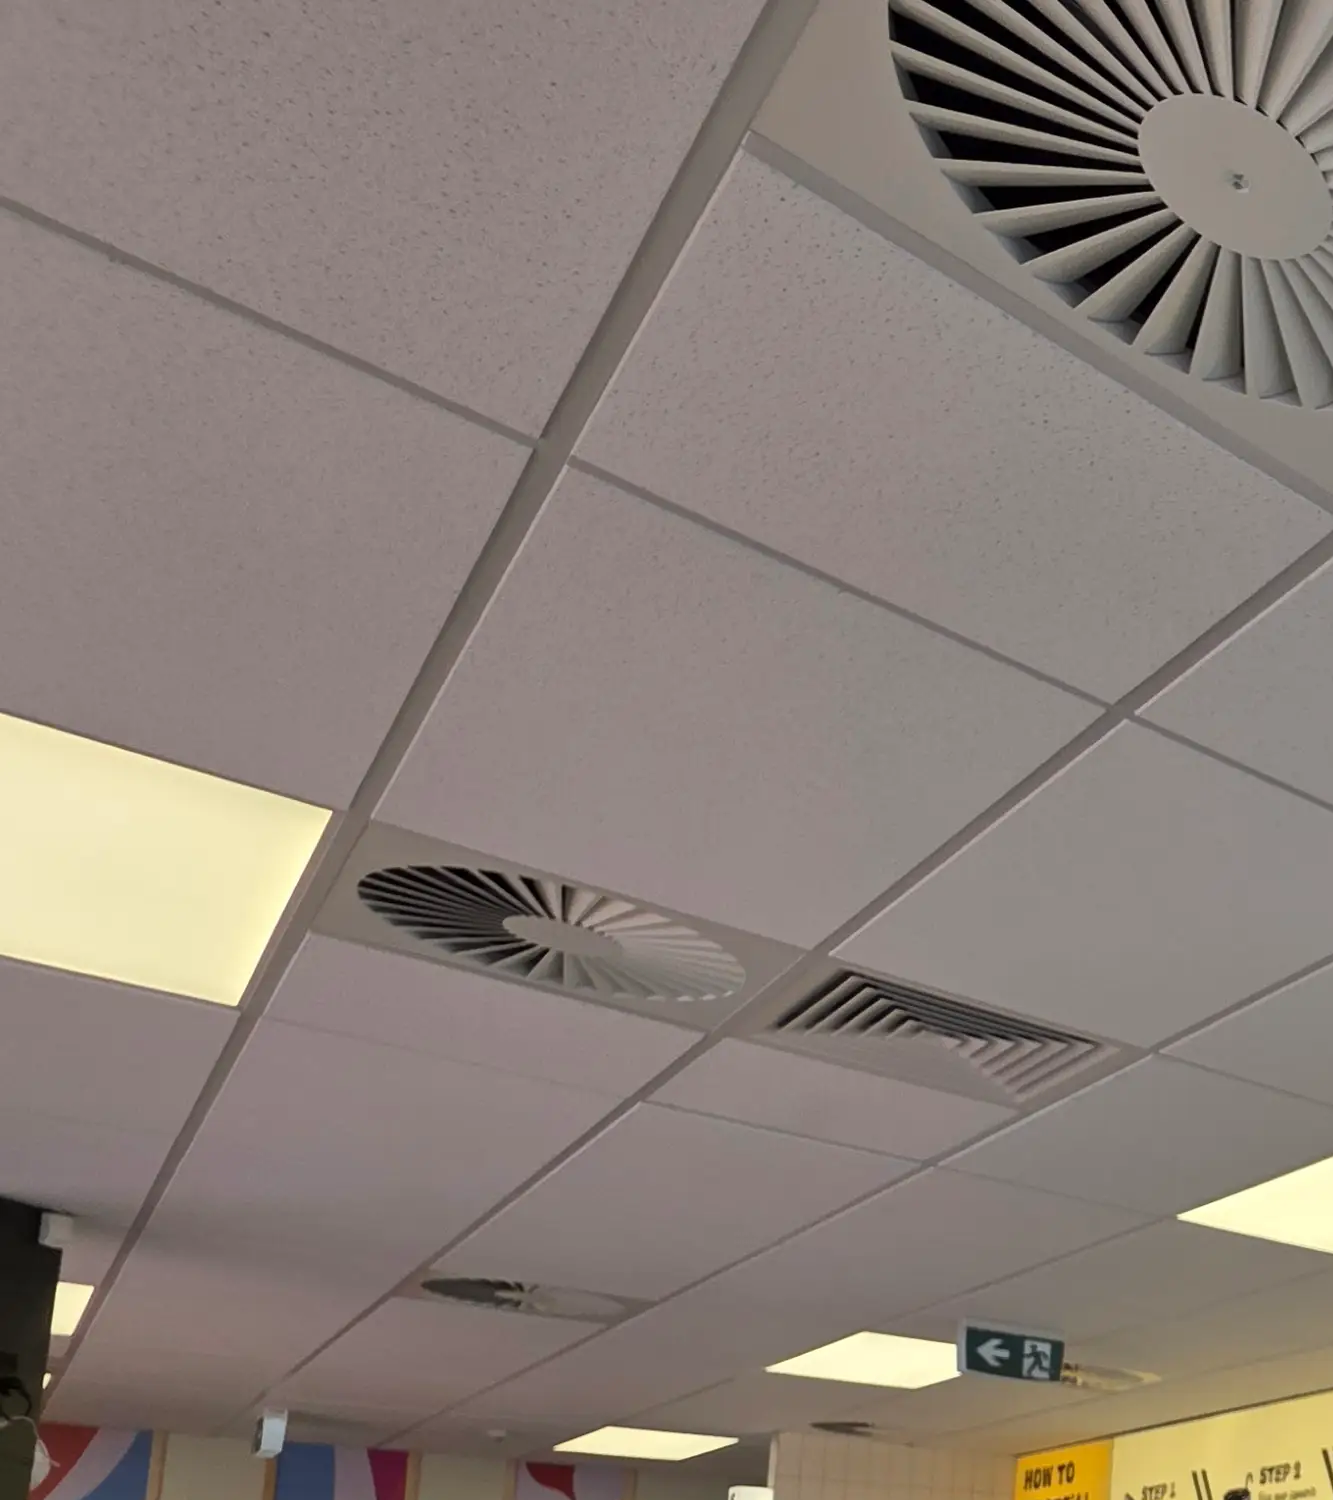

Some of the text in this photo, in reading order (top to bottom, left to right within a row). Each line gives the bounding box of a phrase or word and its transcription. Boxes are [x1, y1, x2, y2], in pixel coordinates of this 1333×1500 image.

[1023, 1460, 1075, 1491] HOW TO
[1259, 1460, 1301, 1485] STEP 2
[1170, 1481, 1176, 1498] 1
